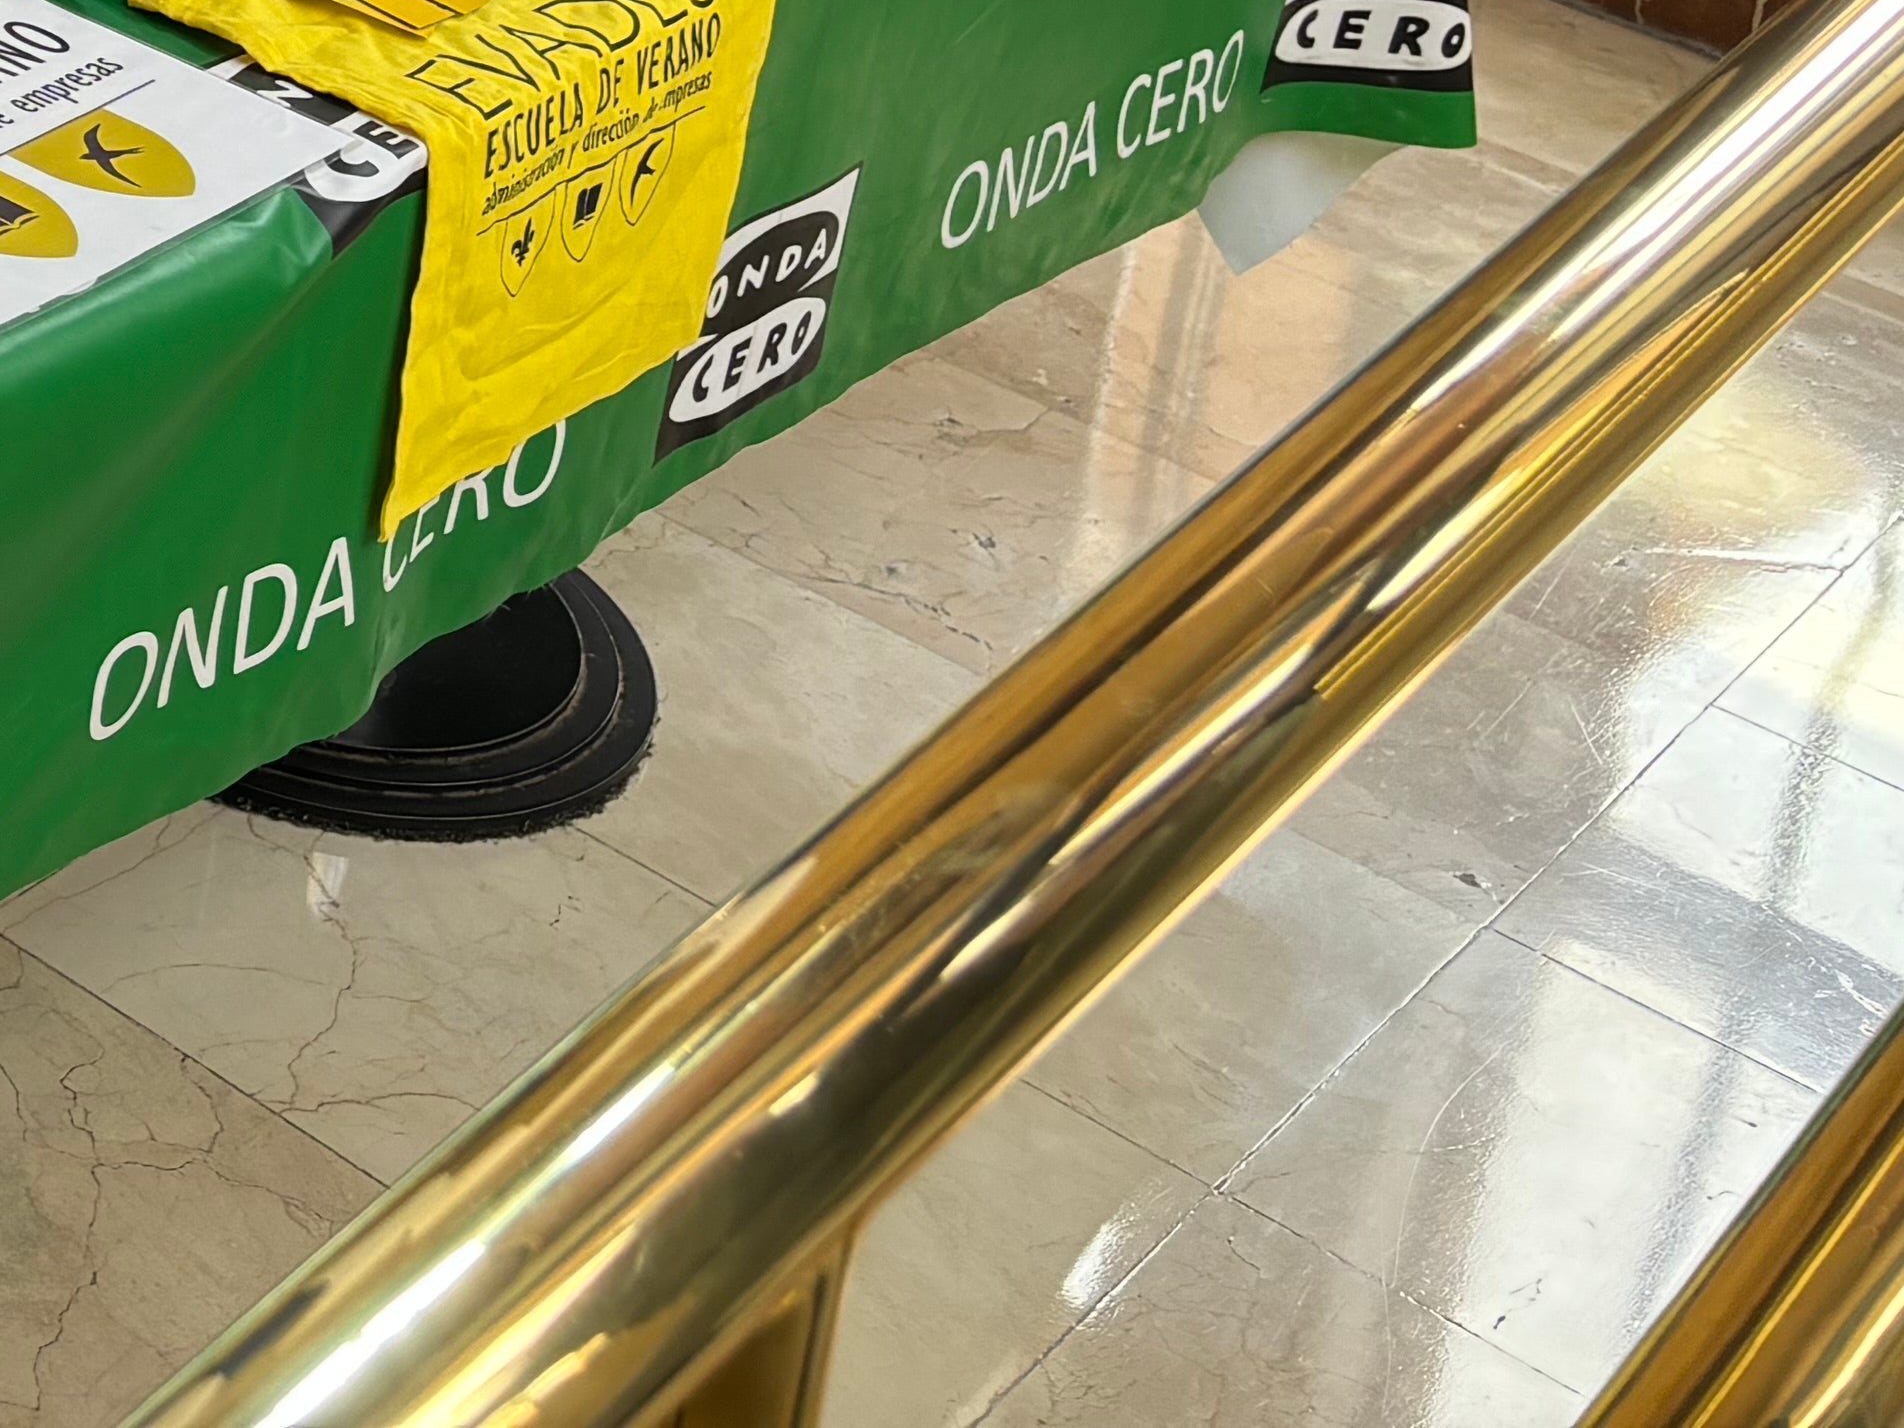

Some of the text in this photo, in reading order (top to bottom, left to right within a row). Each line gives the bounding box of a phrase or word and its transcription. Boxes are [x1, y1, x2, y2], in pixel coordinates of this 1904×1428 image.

[1296, 8, 1466, 59] CERO
[12, 56, 125, 122] empresas
[483, 11, 722, 181] ESCUELA DE VERANO
[940, 29, 1245, 250] ONDA CERO
[707, 225, 829, 319] ONDA
[691, 295, 828, 404] CERO
[88, 537, 357, 743] ONDA
